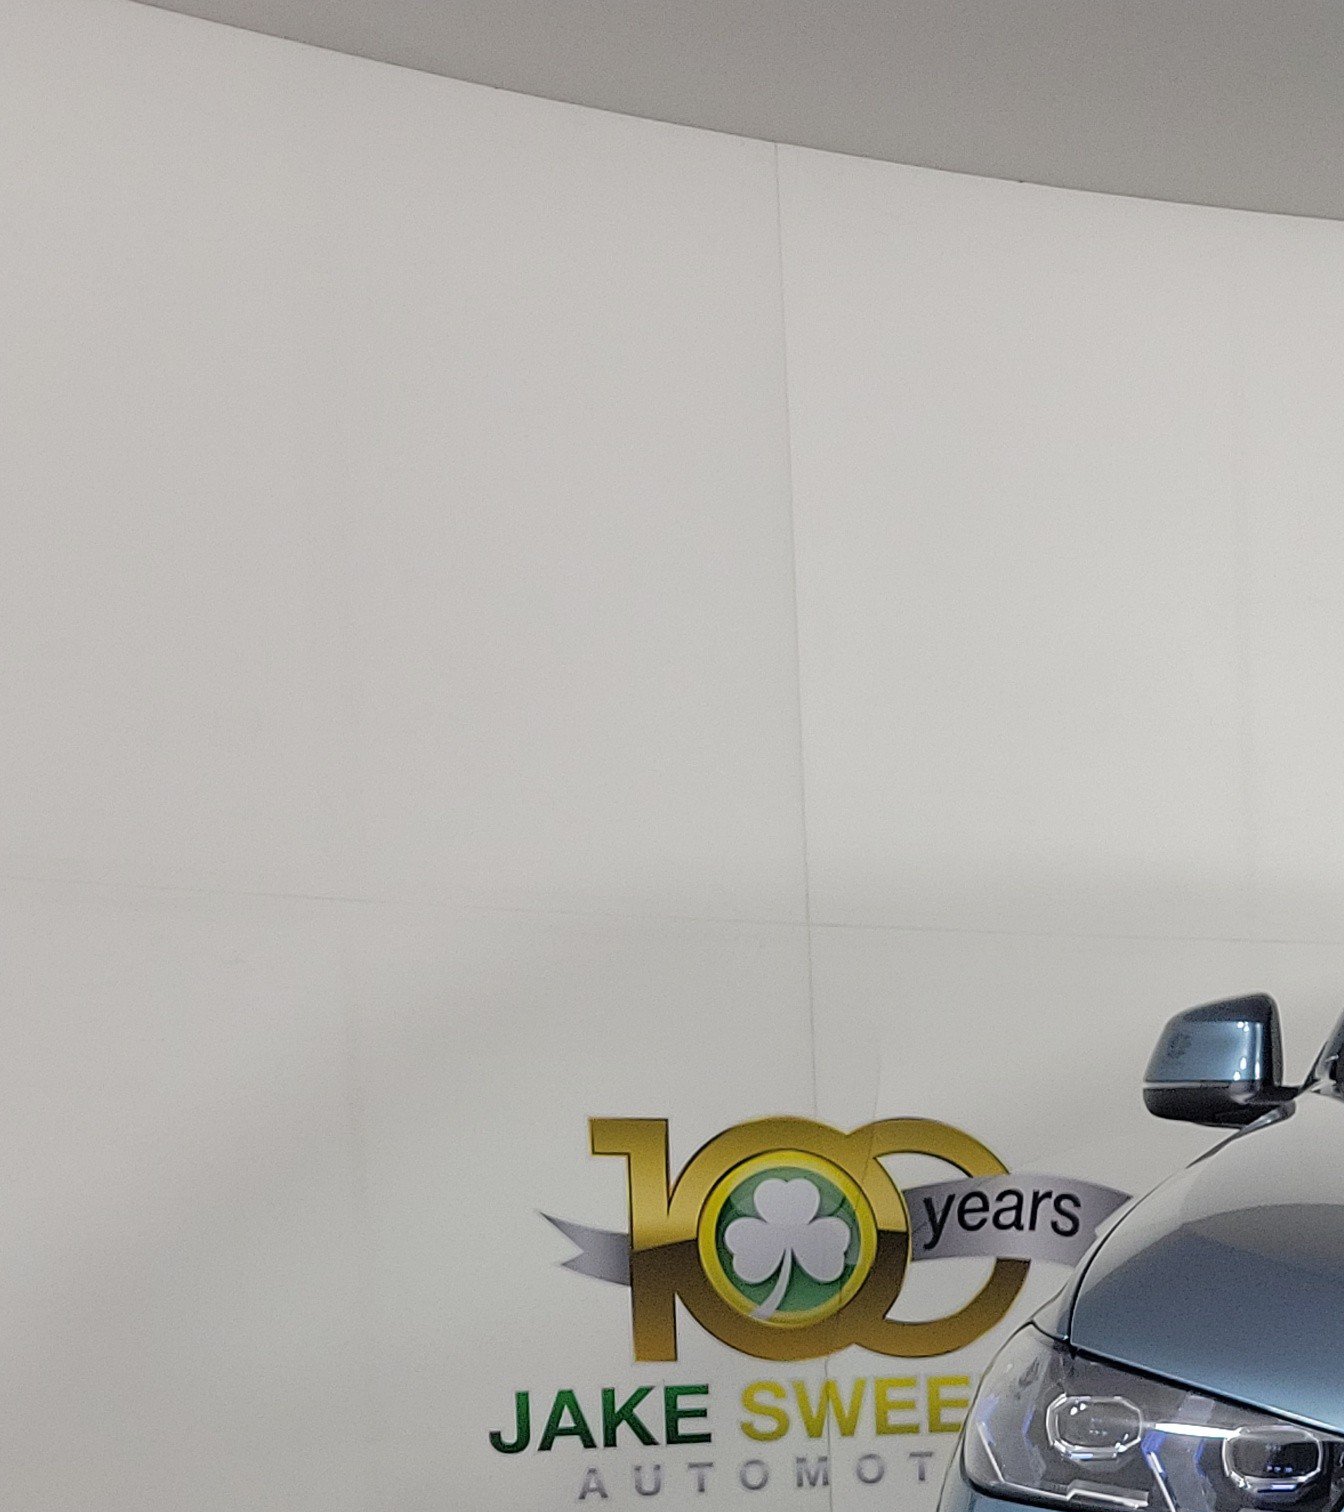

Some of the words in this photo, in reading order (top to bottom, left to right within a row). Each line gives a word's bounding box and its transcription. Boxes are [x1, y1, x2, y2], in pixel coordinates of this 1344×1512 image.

[588, 1115, 1031, 1362] 100
[921, 1185, 1082, 1251] years
[488, 1384, 712, 1454] JAKE
[739, 1374, 970, 1442] SWEE
[577, 1450, 934, 1501] AUTOMOT
